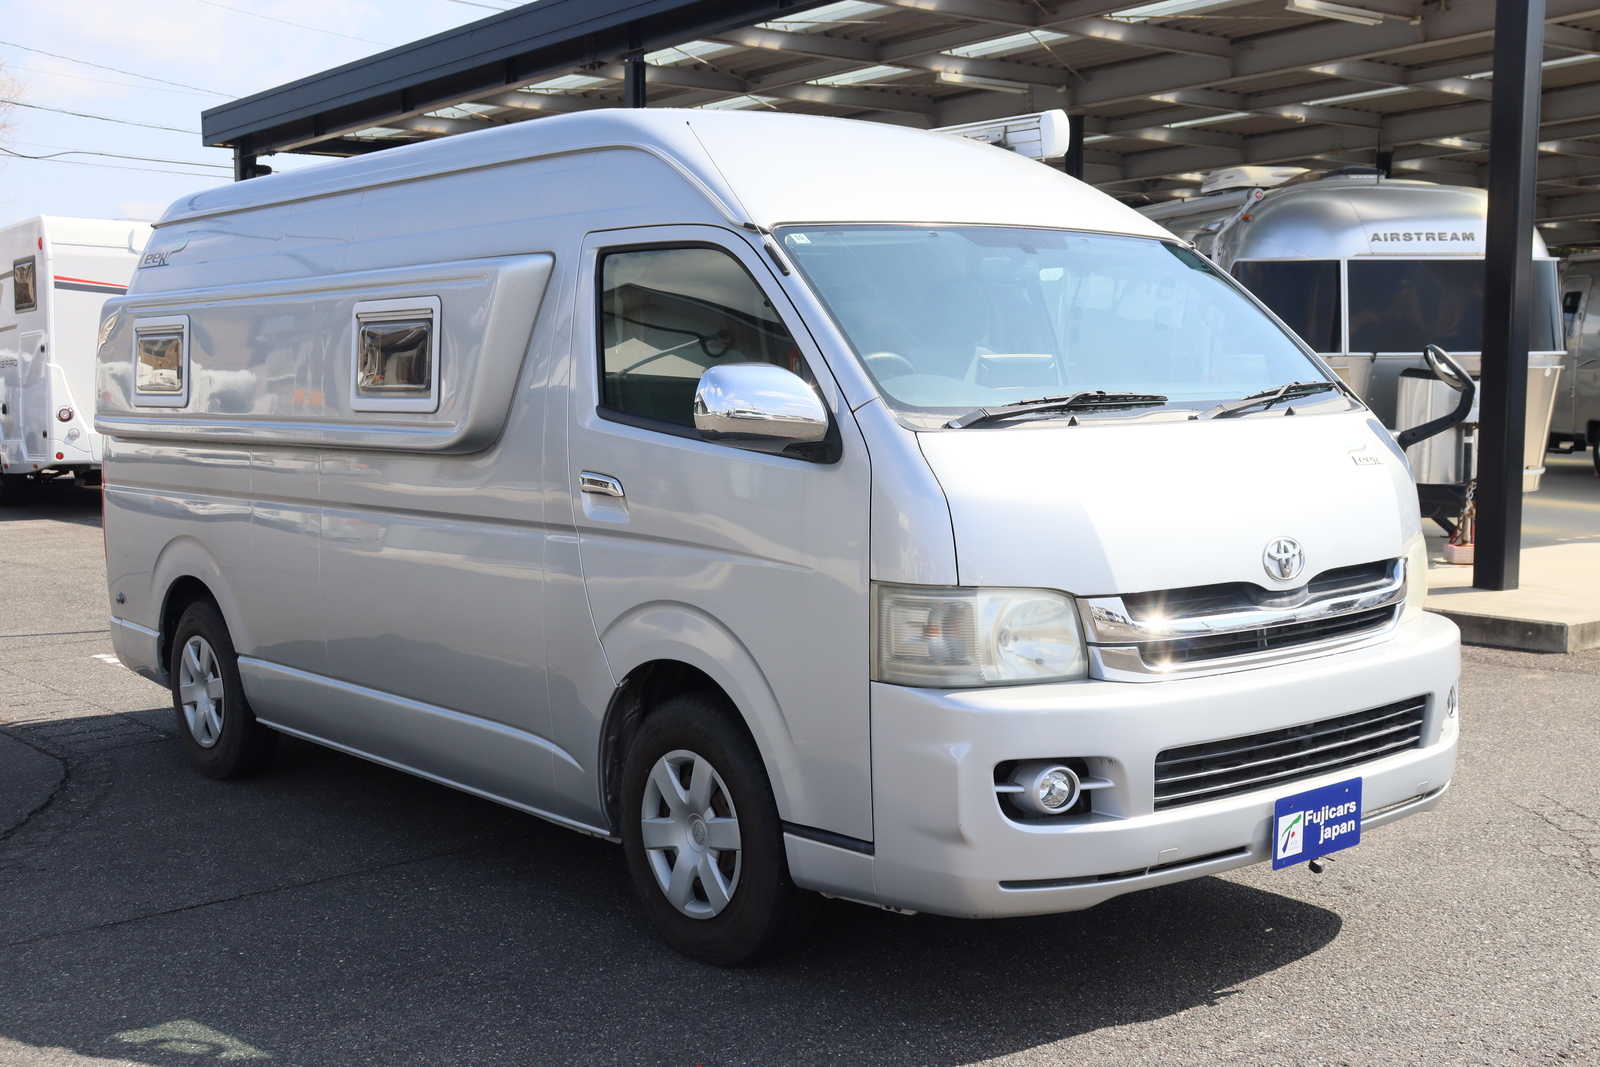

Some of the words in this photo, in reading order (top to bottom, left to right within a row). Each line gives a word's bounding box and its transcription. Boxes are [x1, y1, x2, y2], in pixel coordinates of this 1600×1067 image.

[1371, 232, 1475, 242] AIRSTREAM
[1305, 801, 1357, 826] Fujicars
[1318, 819, 1356, 844] japan
